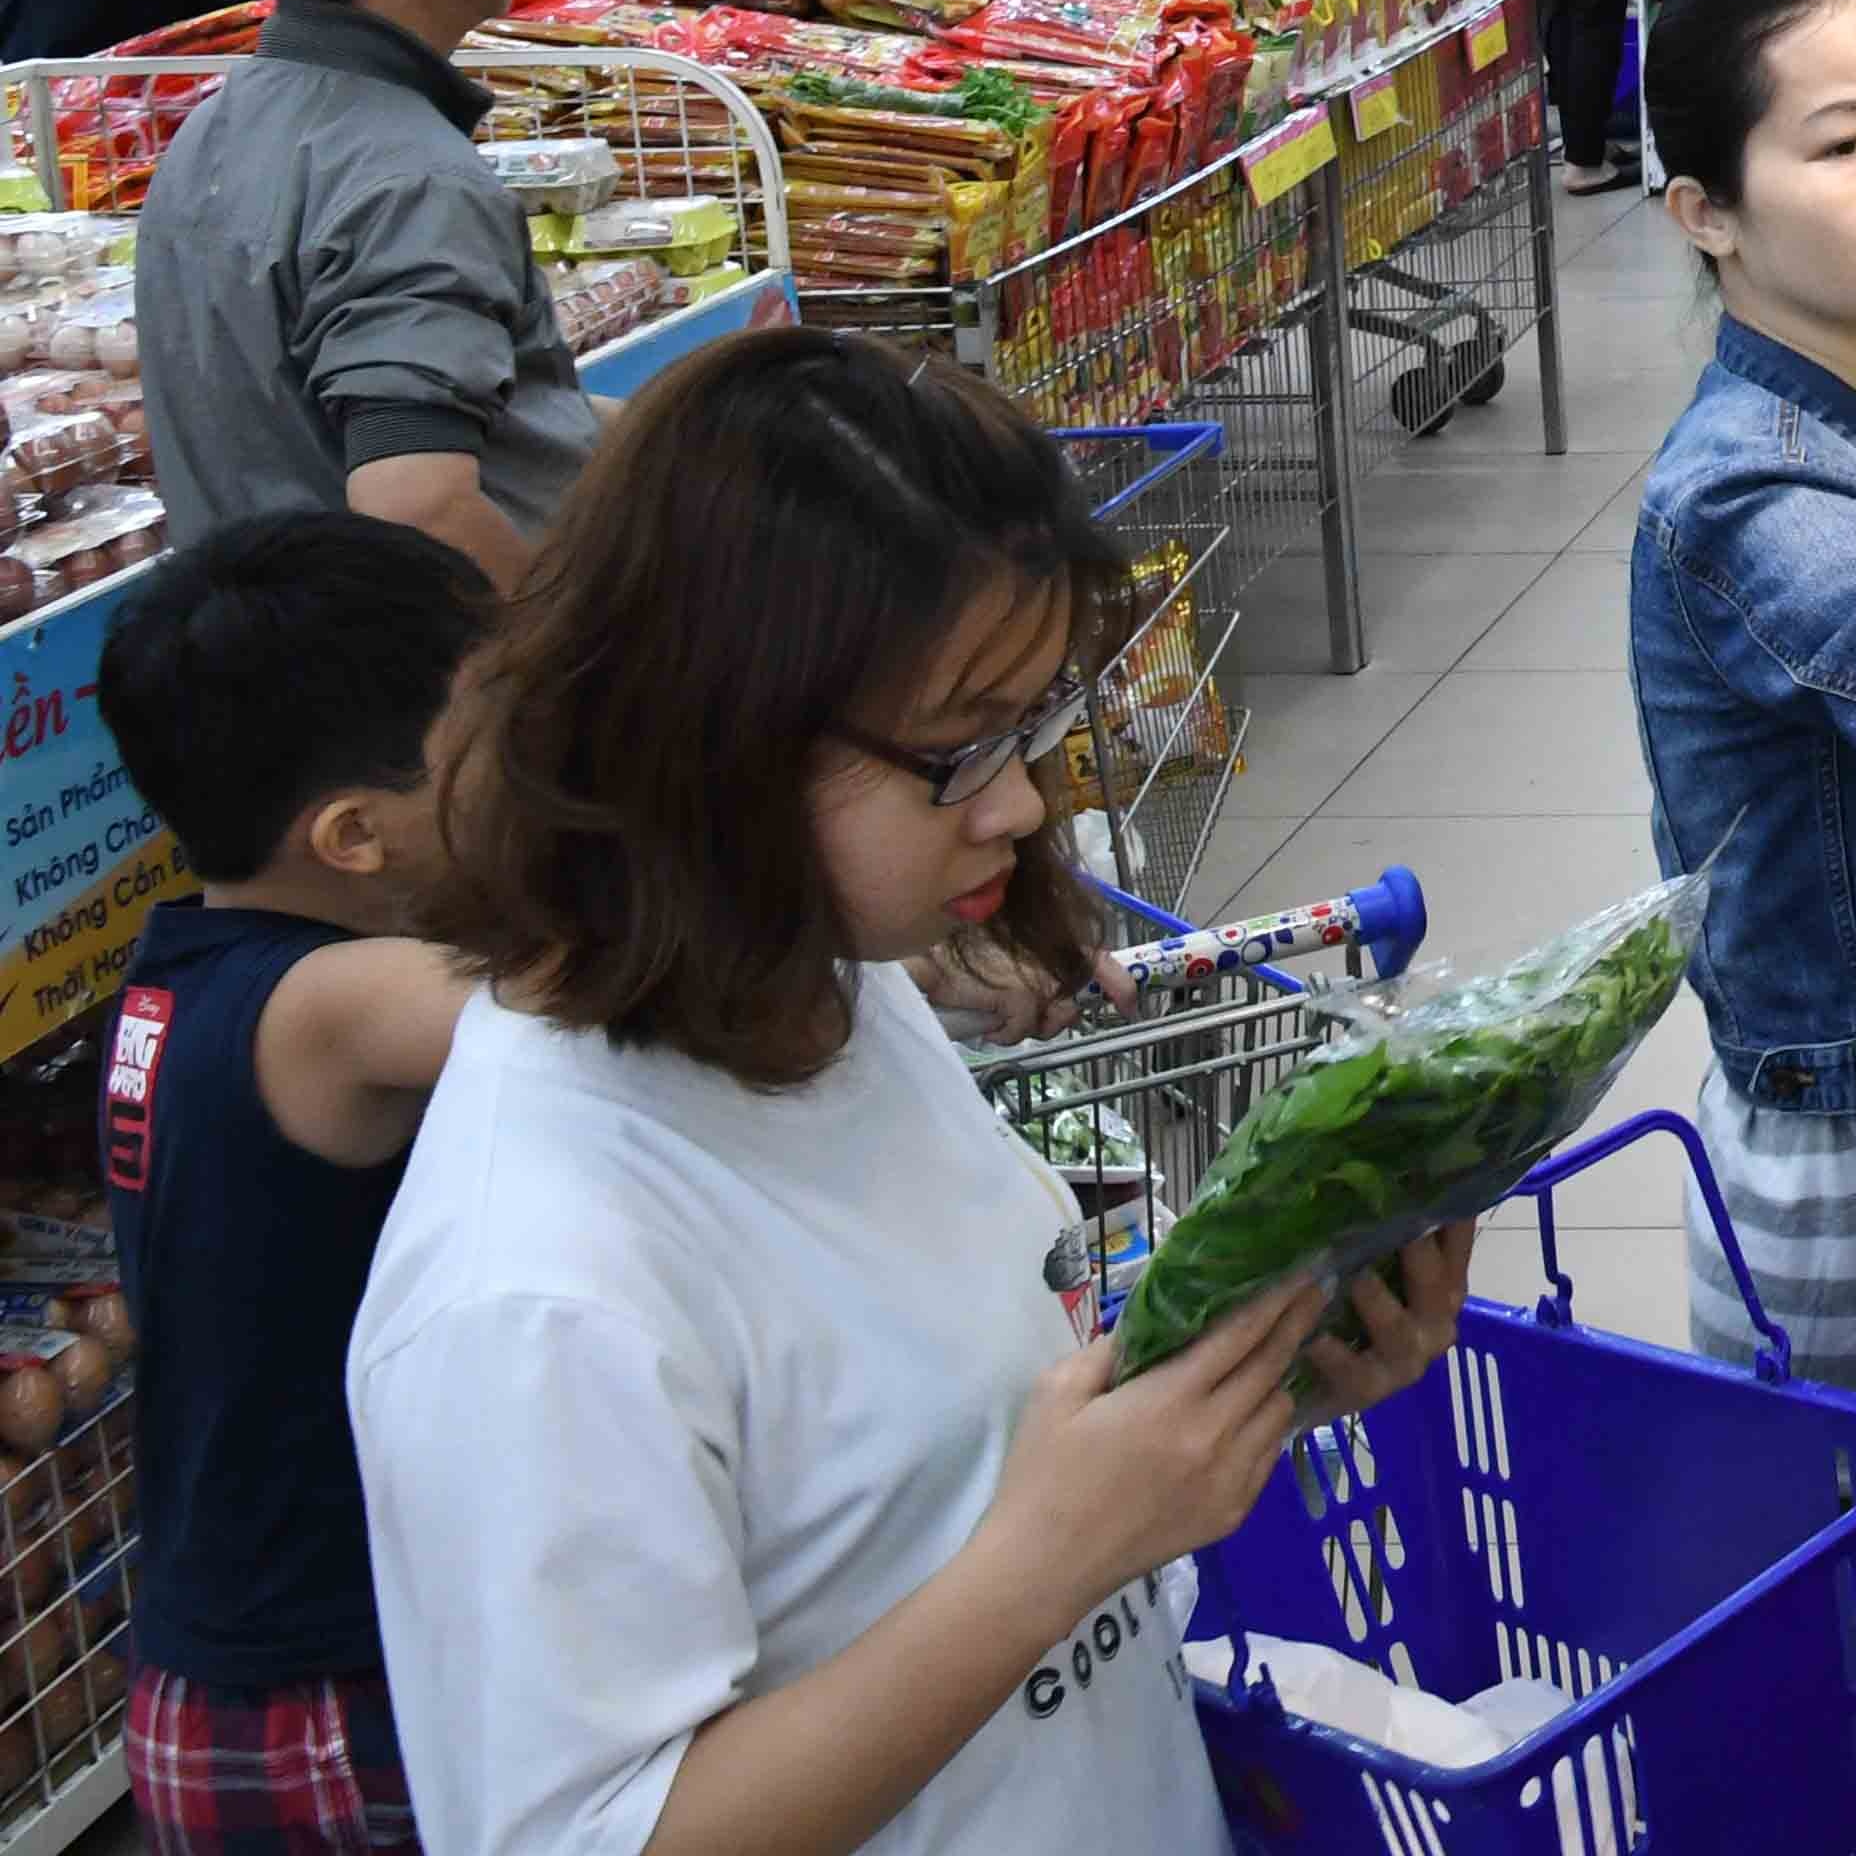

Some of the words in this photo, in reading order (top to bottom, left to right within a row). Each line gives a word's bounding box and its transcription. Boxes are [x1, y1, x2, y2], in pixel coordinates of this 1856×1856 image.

[4, 800, 57, 849] Sản
[14, 844, 101, 908] Không
[23, 896, 108, 966] Không
